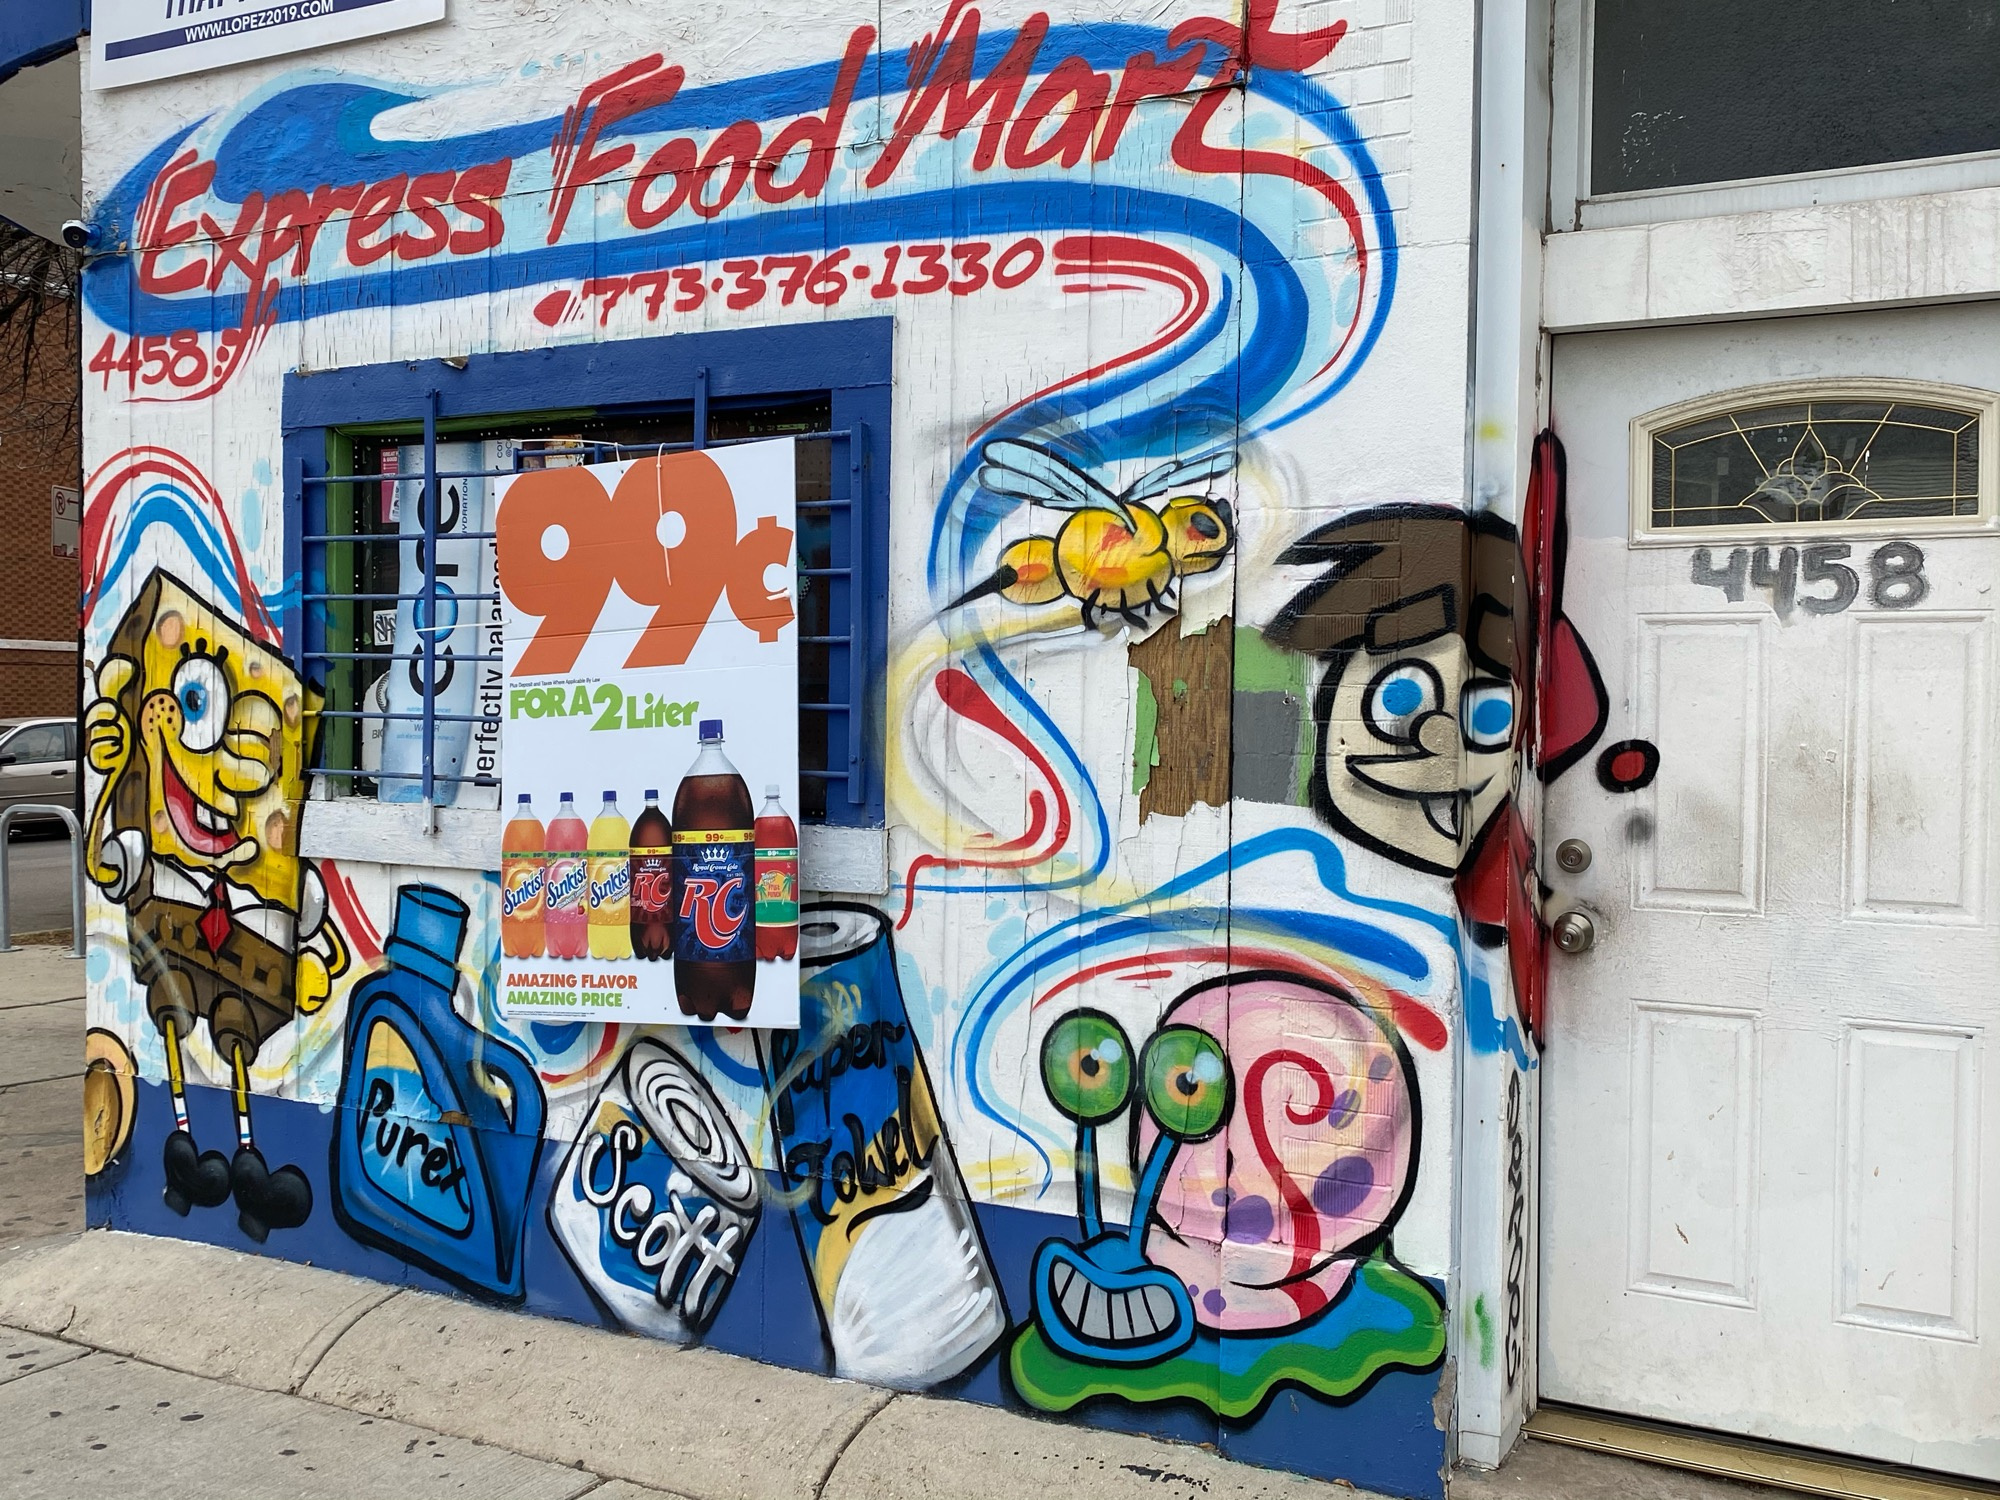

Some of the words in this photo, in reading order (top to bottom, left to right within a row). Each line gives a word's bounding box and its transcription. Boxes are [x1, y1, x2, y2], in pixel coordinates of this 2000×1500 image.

[185, 0, 334, 42] WWW.LOPEZ2019.COM
[137, 150, 512, 335] Express
[551, 25, 879, 244] Food
[867, 0, 1347, 188] Mart
[1690, 540, 1930, 621] 4458
[510, 687, 568, 720] FOR
[569, 685, 593, 716] A
[590, 683, 624, 731] 2
[627, 693, 699, 730] Liter
[504, 867, 545, 916] Sunkist
[547, 860, 587, 908] Sunkist
[632, 873, 672, 912] RC
[680, 878, 748, 948] RC
[506, 973, 577, 988] AMAZING
[581, 974, 638, 989] FLAVOR
[506, 991, 577, 1006] AMAZING
[581, 992, 623, 1007] PRICE
[359, 1078, 470, 1213] Purex
[580, 1118, 738, 1322] Scott
